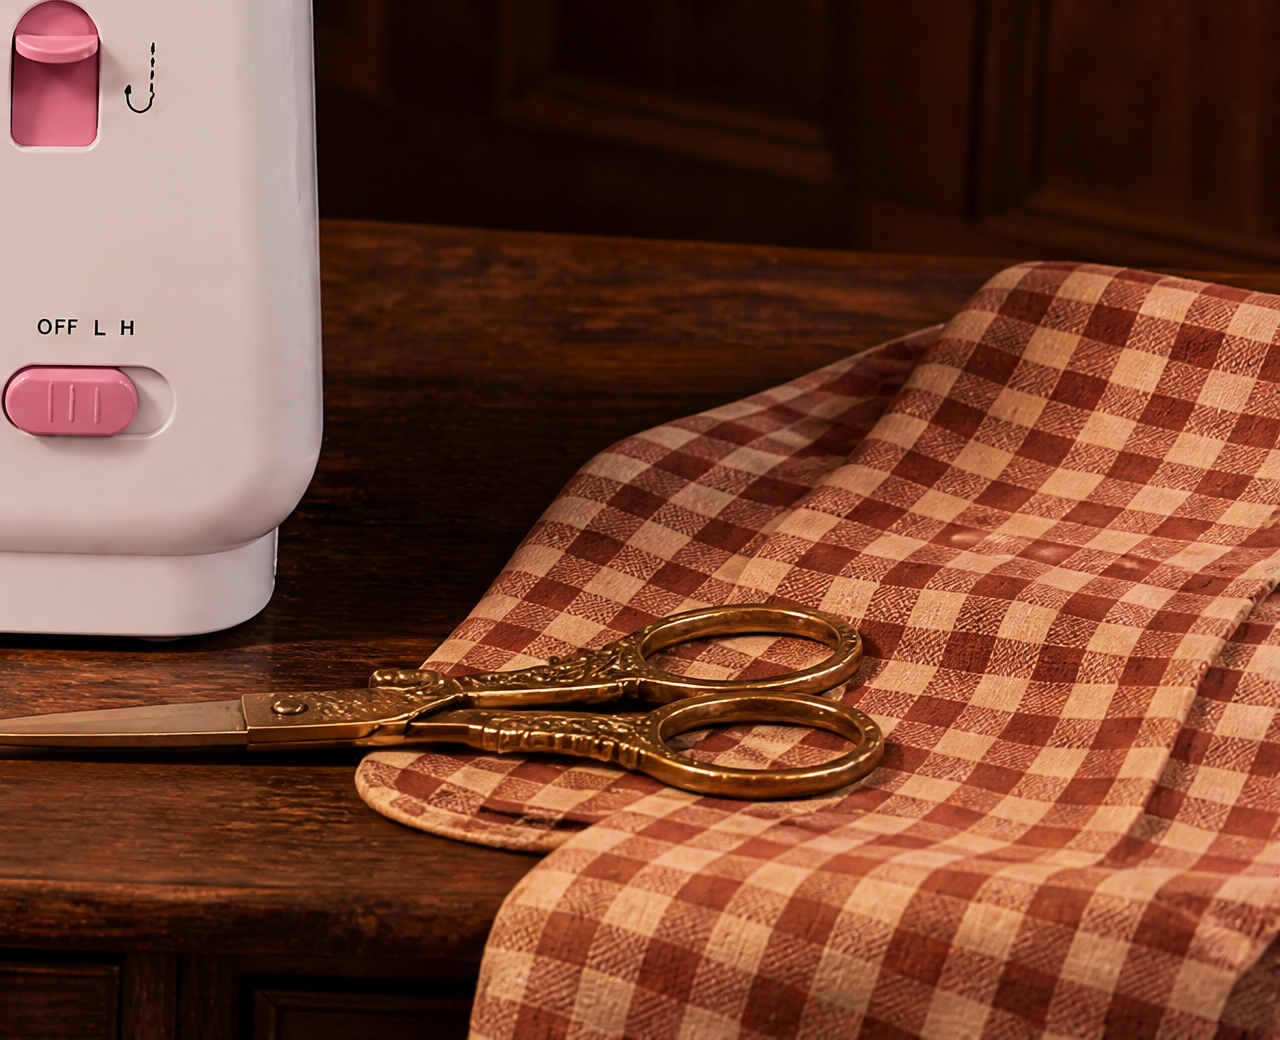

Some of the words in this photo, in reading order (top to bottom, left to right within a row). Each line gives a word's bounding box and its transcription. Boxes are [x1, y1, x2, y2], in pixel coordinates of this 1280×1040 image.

[37, 318, 79, 335] OFF
[94, 319, 106, 336] L
[120, 319, 134, 336] H
